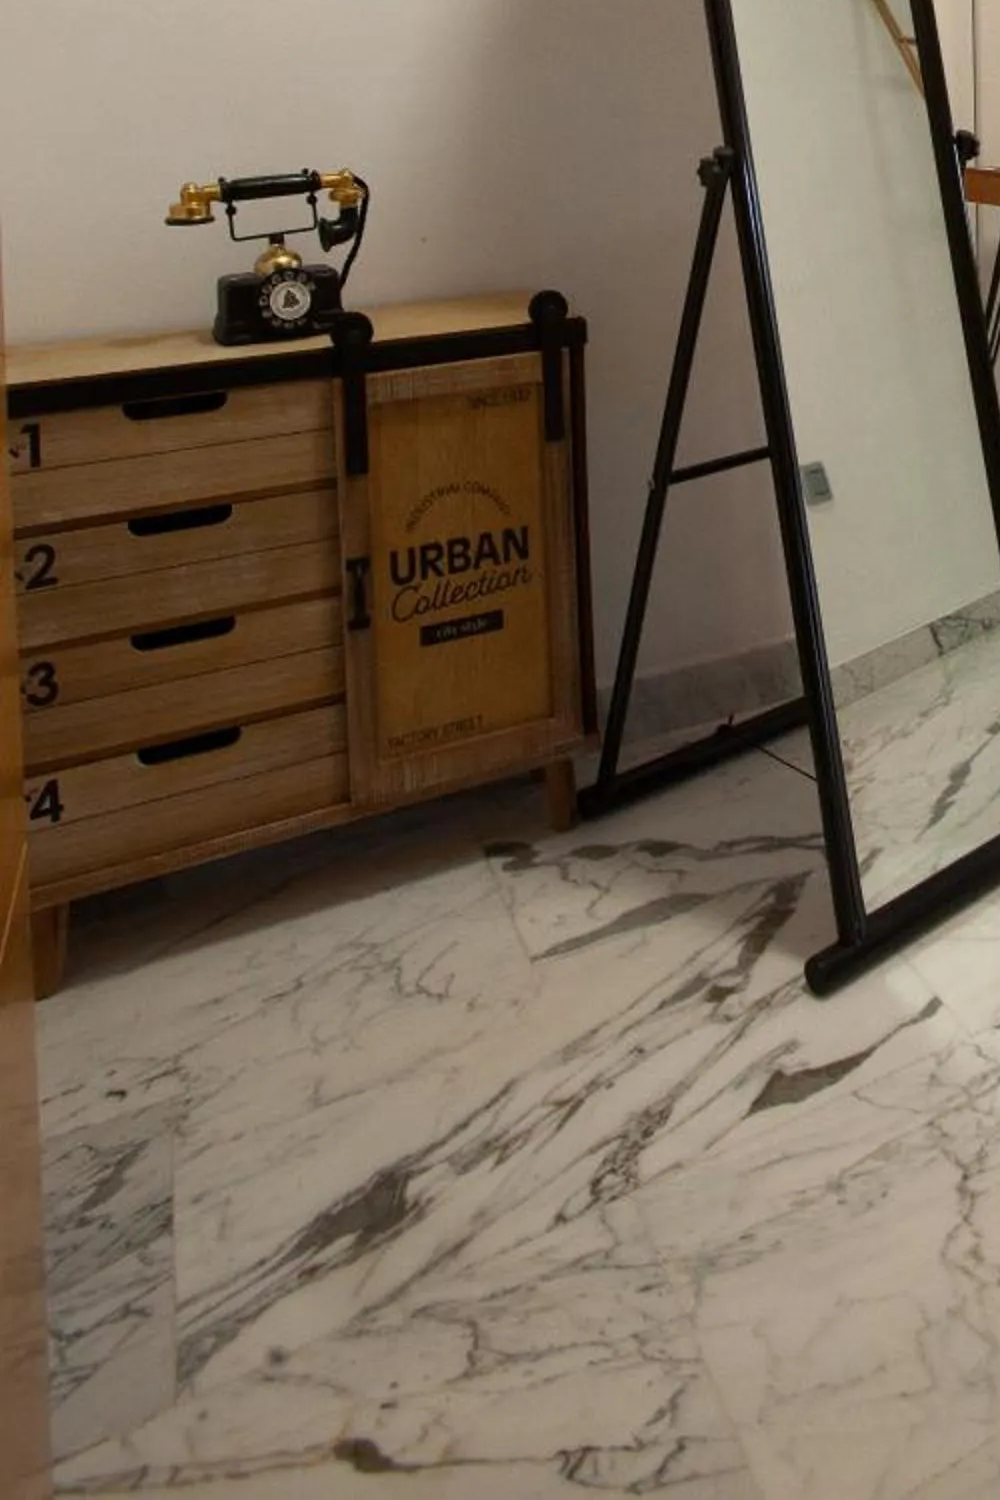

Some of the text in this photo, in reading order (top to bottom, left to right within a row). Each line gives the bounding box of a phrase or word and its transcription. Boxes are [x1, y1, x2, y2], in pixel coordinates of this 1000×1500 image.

[20, 423, 41, 468] 1
[24, 543, 58, 590] 2
[390, 525, 529, 586] URBAN
[391, 565, 532, 623] Collection
[26, 660, 59, 706] 3
[30, 778, 64, 823] 4
